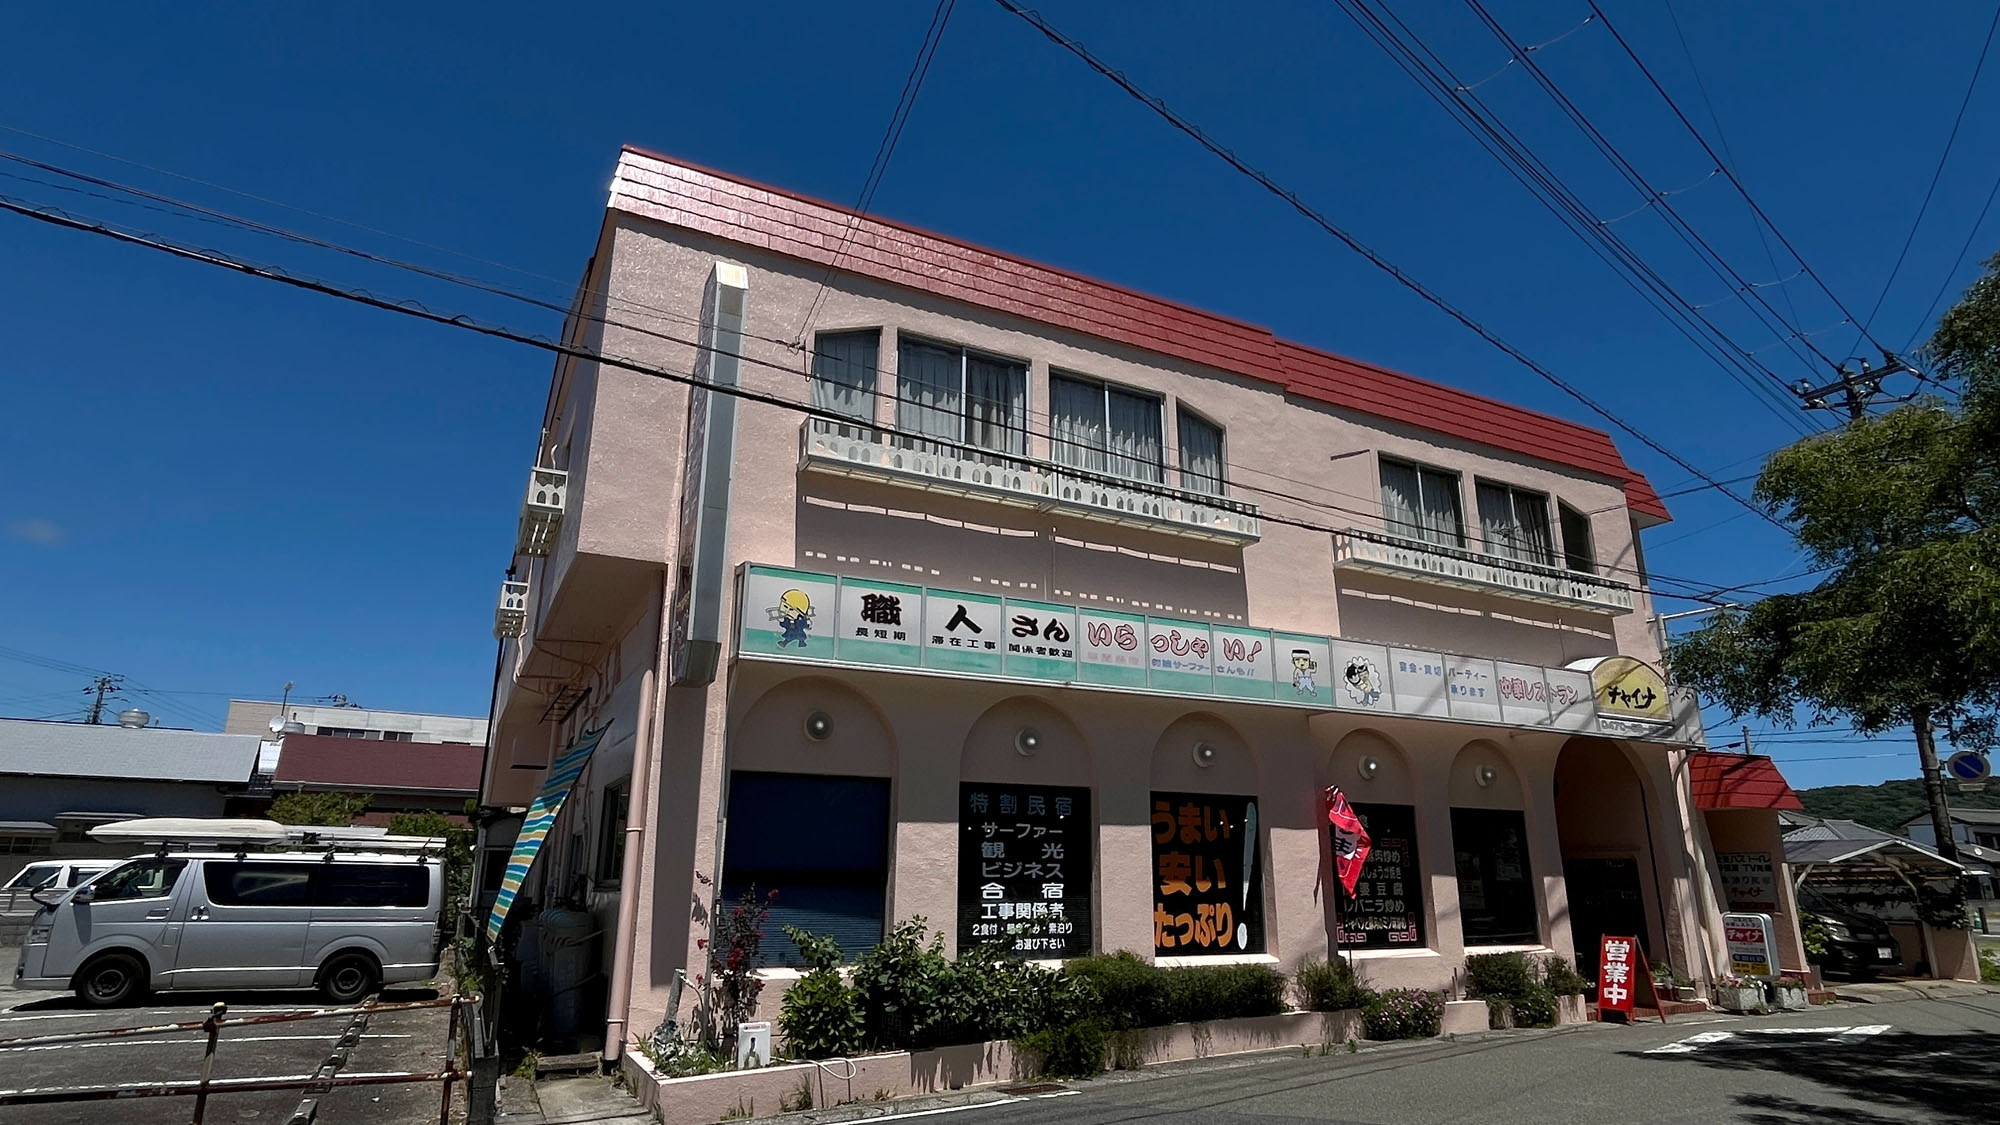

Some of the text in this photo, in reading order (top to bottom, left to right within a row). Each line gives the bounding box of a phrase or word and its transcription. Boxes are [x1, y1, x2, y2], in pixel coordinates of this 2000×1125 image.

[855, 627, 1073, 658] 長短期 滞在工事 関係者歓迎
[1499, 676, 1579, 705] 中華レストラン
[1608, 685, 1657, 709] チャイナ
[970, 792, 1073, 816] 特割民宿
[981, 822, 1063, 838] サーファー
[1152, 801, 1230, 845] うまい
[981, 842, 1064, 859] 観光
[981, 862, 1064, 878] ビジネス
[1159, 851, 1226, 896] 安い
[981, 882, 1064, 899] 合宿
[981, 902, 1065, 919] 工事関係者
[1154, 902, 1233, 948] たっぷり
[1727, 929, 1763, 942] チャイナ
[1603, 940, 1630, 1005] 営業中
